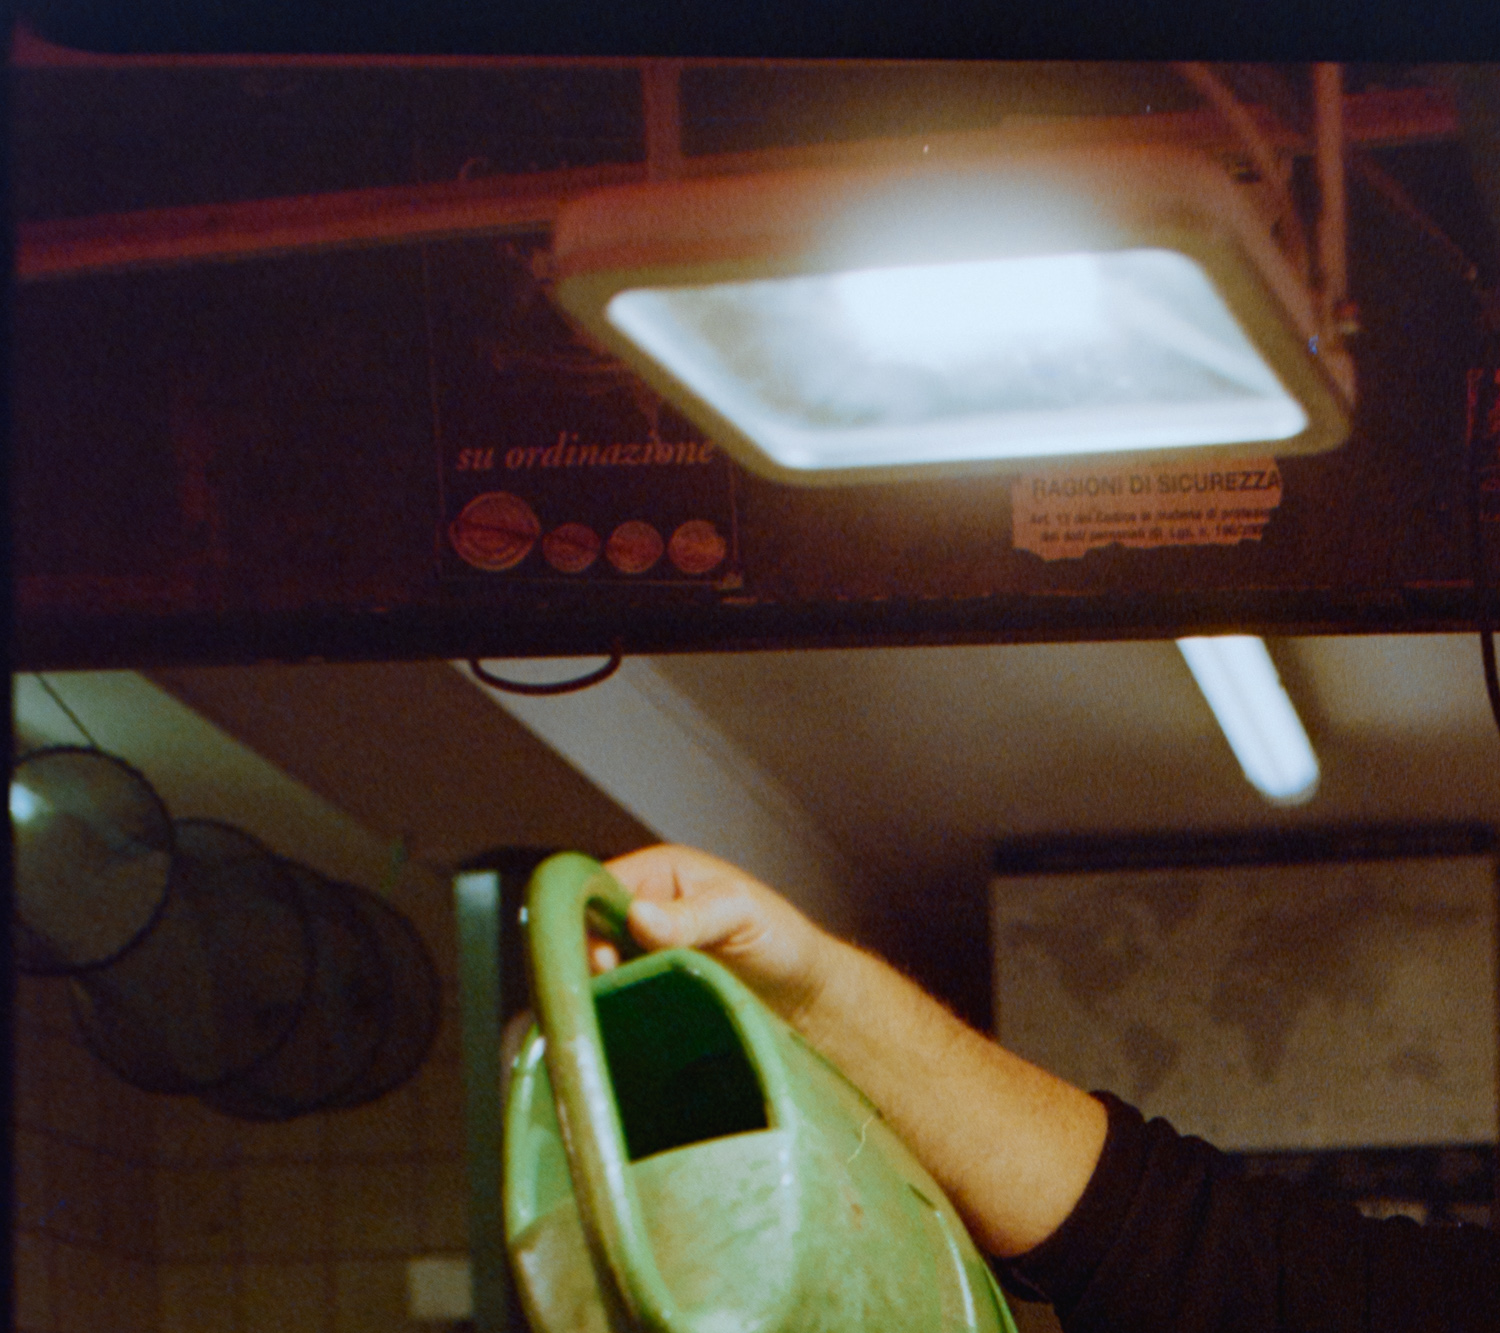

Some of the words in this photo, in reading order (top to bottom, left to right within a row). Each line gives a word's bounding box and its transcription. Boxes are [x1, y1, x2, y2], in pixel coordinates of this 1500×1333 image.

[455, 446, 494, 471] su
[504, 431, 715, 467] ordinazione
[1032, 475, 1122, 497] RAGIONI
[1130, 473, 1151, 494] DI
[1158, 470, 1282, 493] SICUREZZA
